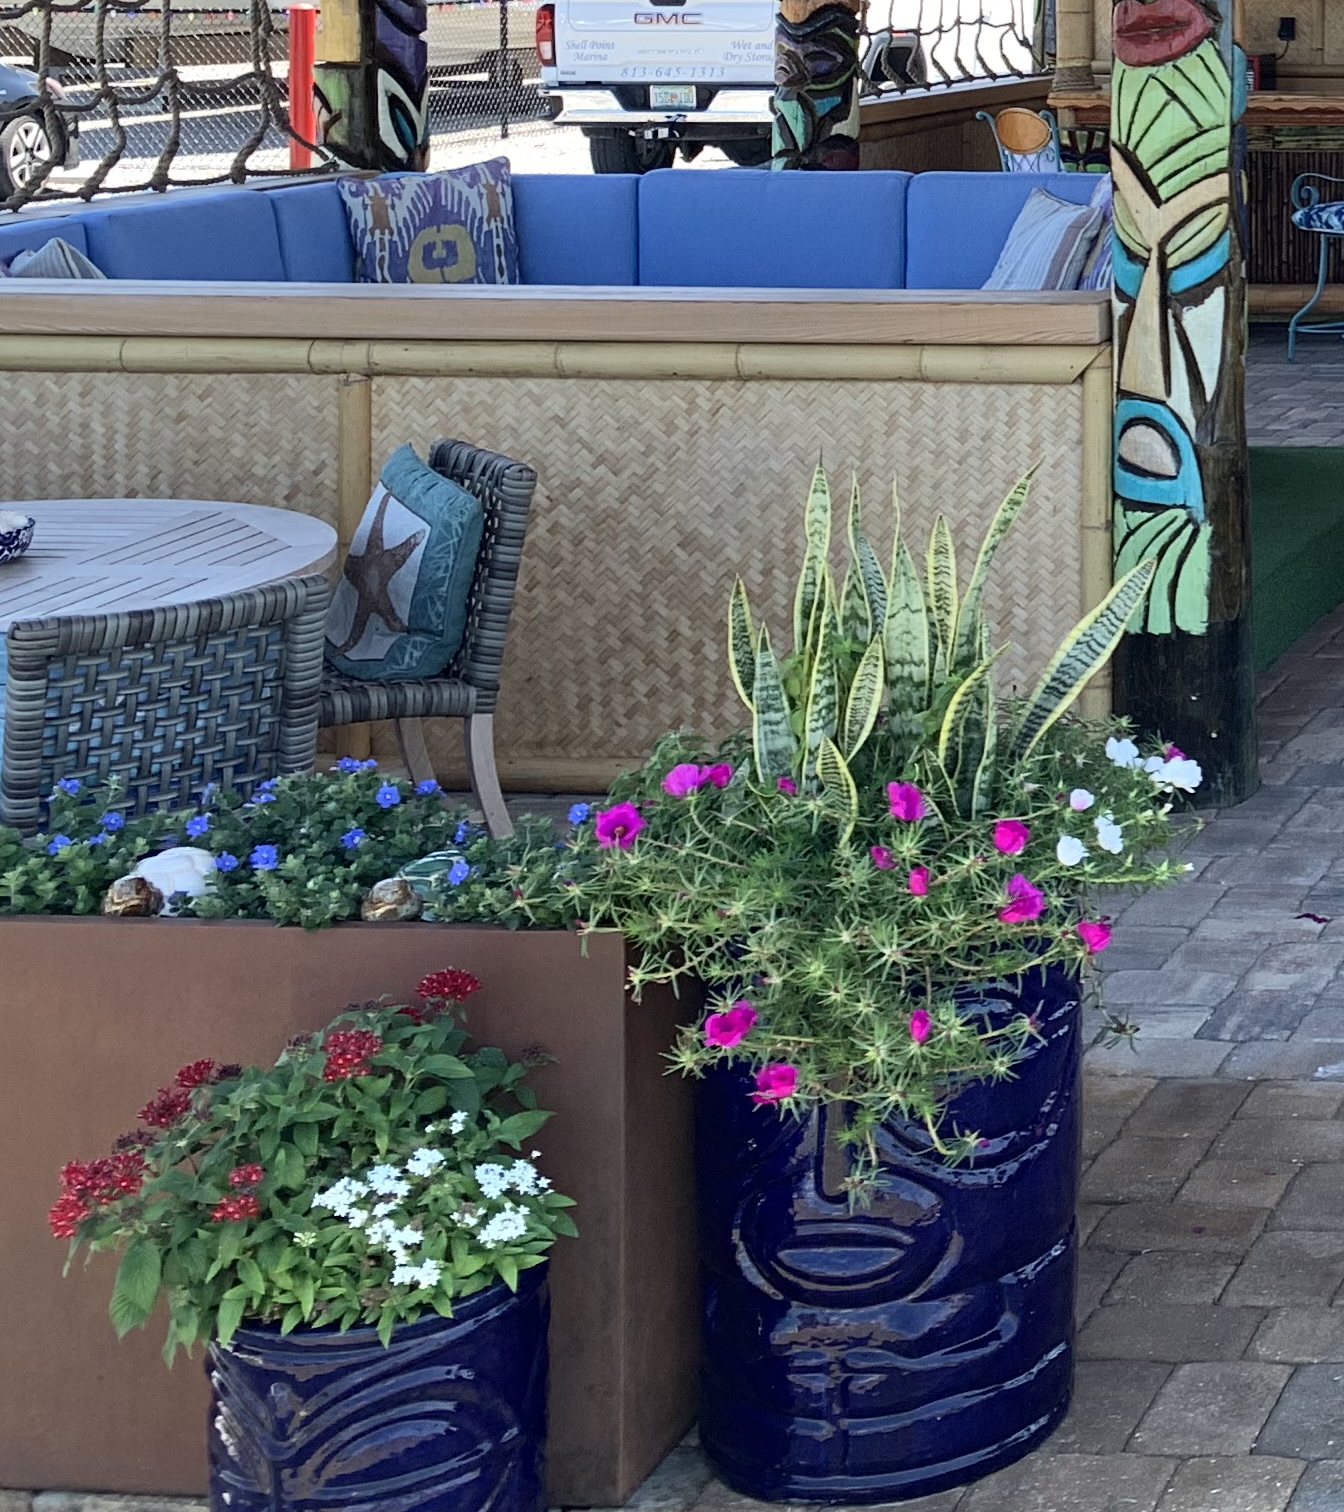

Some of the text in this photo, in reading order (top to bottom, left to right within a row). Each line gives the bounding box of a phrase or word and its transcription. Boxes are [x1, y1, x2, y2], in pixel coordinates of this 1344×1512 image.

[634, 13, 704, 25] GMC
[565, 39, 615, 50] Shell Point
[730, 39, 774, 50] Wet and
[573, 51, 608, 62] Marina
[722, 51, 743, 64] Dry
[620, 66, 726, 78] 813-645-1313
